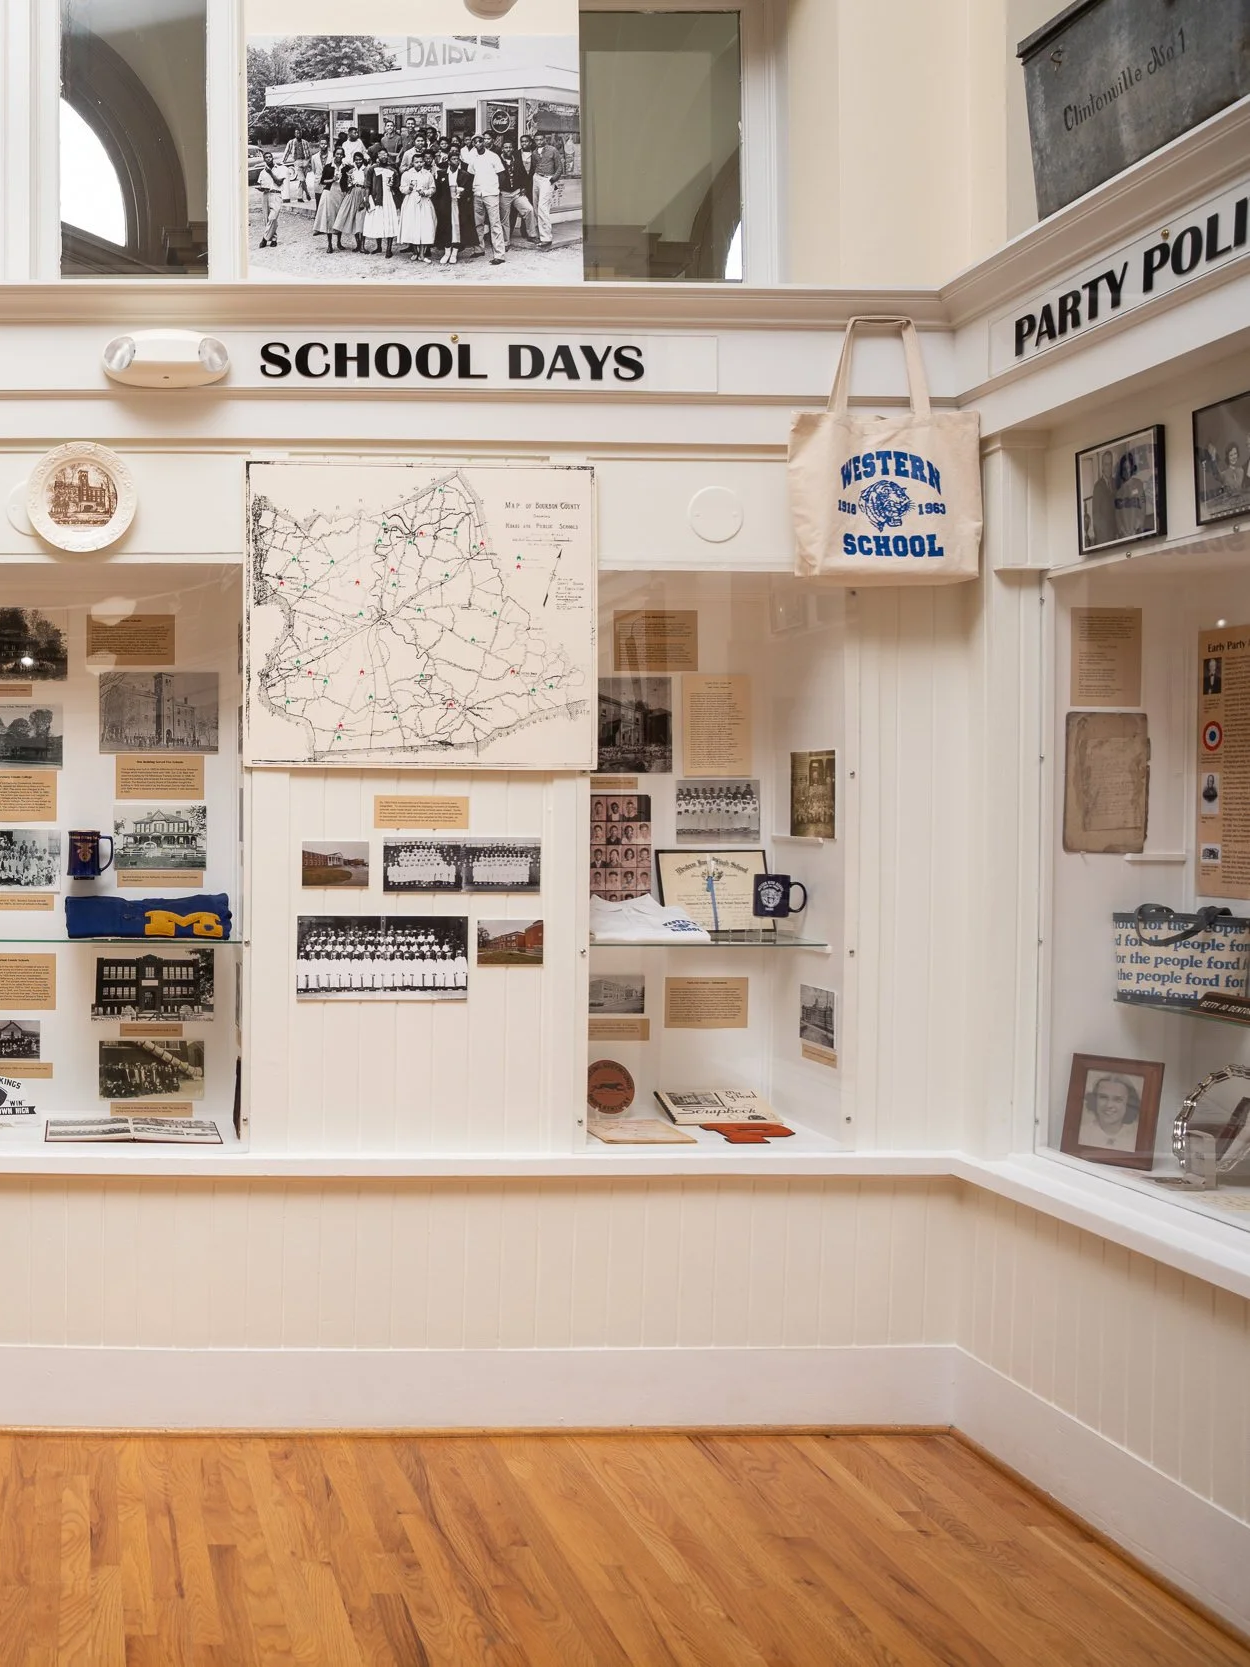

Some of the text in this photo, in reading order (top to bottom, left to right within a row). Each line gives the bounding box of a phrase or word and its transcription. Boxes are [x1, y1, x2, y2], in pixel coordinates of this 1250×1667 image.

[1064, 66, 1142, 131] Clintonville
[1177, 27, 1185, 54] 1
[1015, 261, 1128, 357] PARTY
[260, 342, 645, 381] SCHOOL DAYS
[841, 450, 942, 496] WESTERN
[838, 500, 946, 515] 1918 1963
[843, 532, 944, 557] SCHOOL
[1208, 640, 1246, 653] Early Party
[145, 910, 223, 938] M
[1173, 939, 1225, 953] people
[1130, 952, 1150, 964] the
[1154, 955, 1202, 970] people
[1206, 957, 1240, 970] ford
[1136, 971, 1182, 985] people
[1186, 973, 1220, 987] ford
[1225, 975, 1244, 987] for
[1200, 1001, 1219, 1009] BETTY
[677, 1107, 756, 1117] Scrapbook
